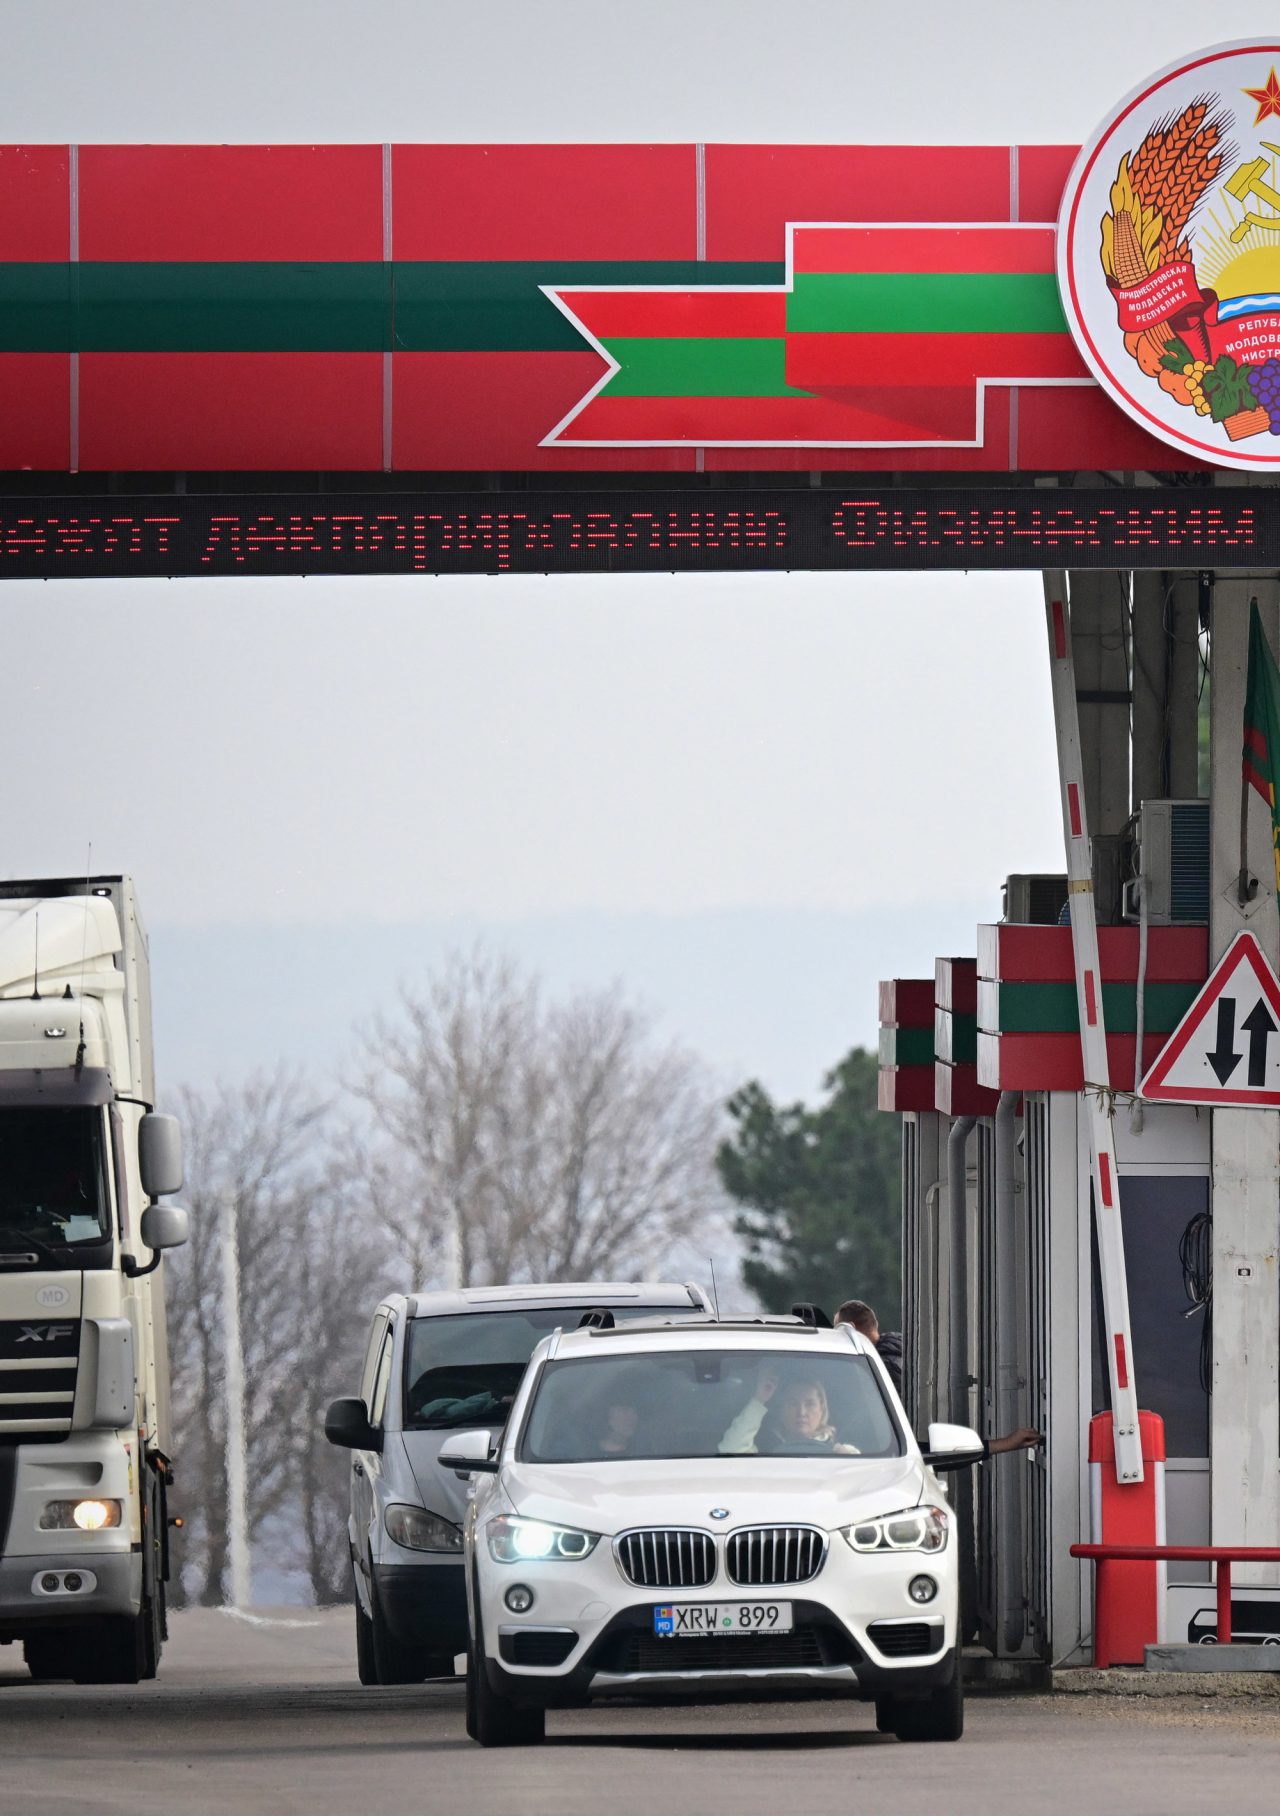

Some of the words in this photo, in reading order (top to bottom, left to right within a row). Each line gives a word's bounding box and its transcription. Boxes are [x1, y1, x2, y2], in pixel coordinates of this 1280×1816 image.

[1119, 265, 1187, 299] ПРИДНЕСТРОВСКАЯ
[1128, 278, 1184, 312] МОЛДАВСКАЯ
[1136, 290, 1188, 323] РЕСПУБЛИКА
[42, 1291, 64, 1302] MD
[15, 1325, 74, 1342] XF
[657, 1621, 671, 1631] MD
[676, 1607, 718, 1630] XRW
[739, 1606, 779, 1628] 899
